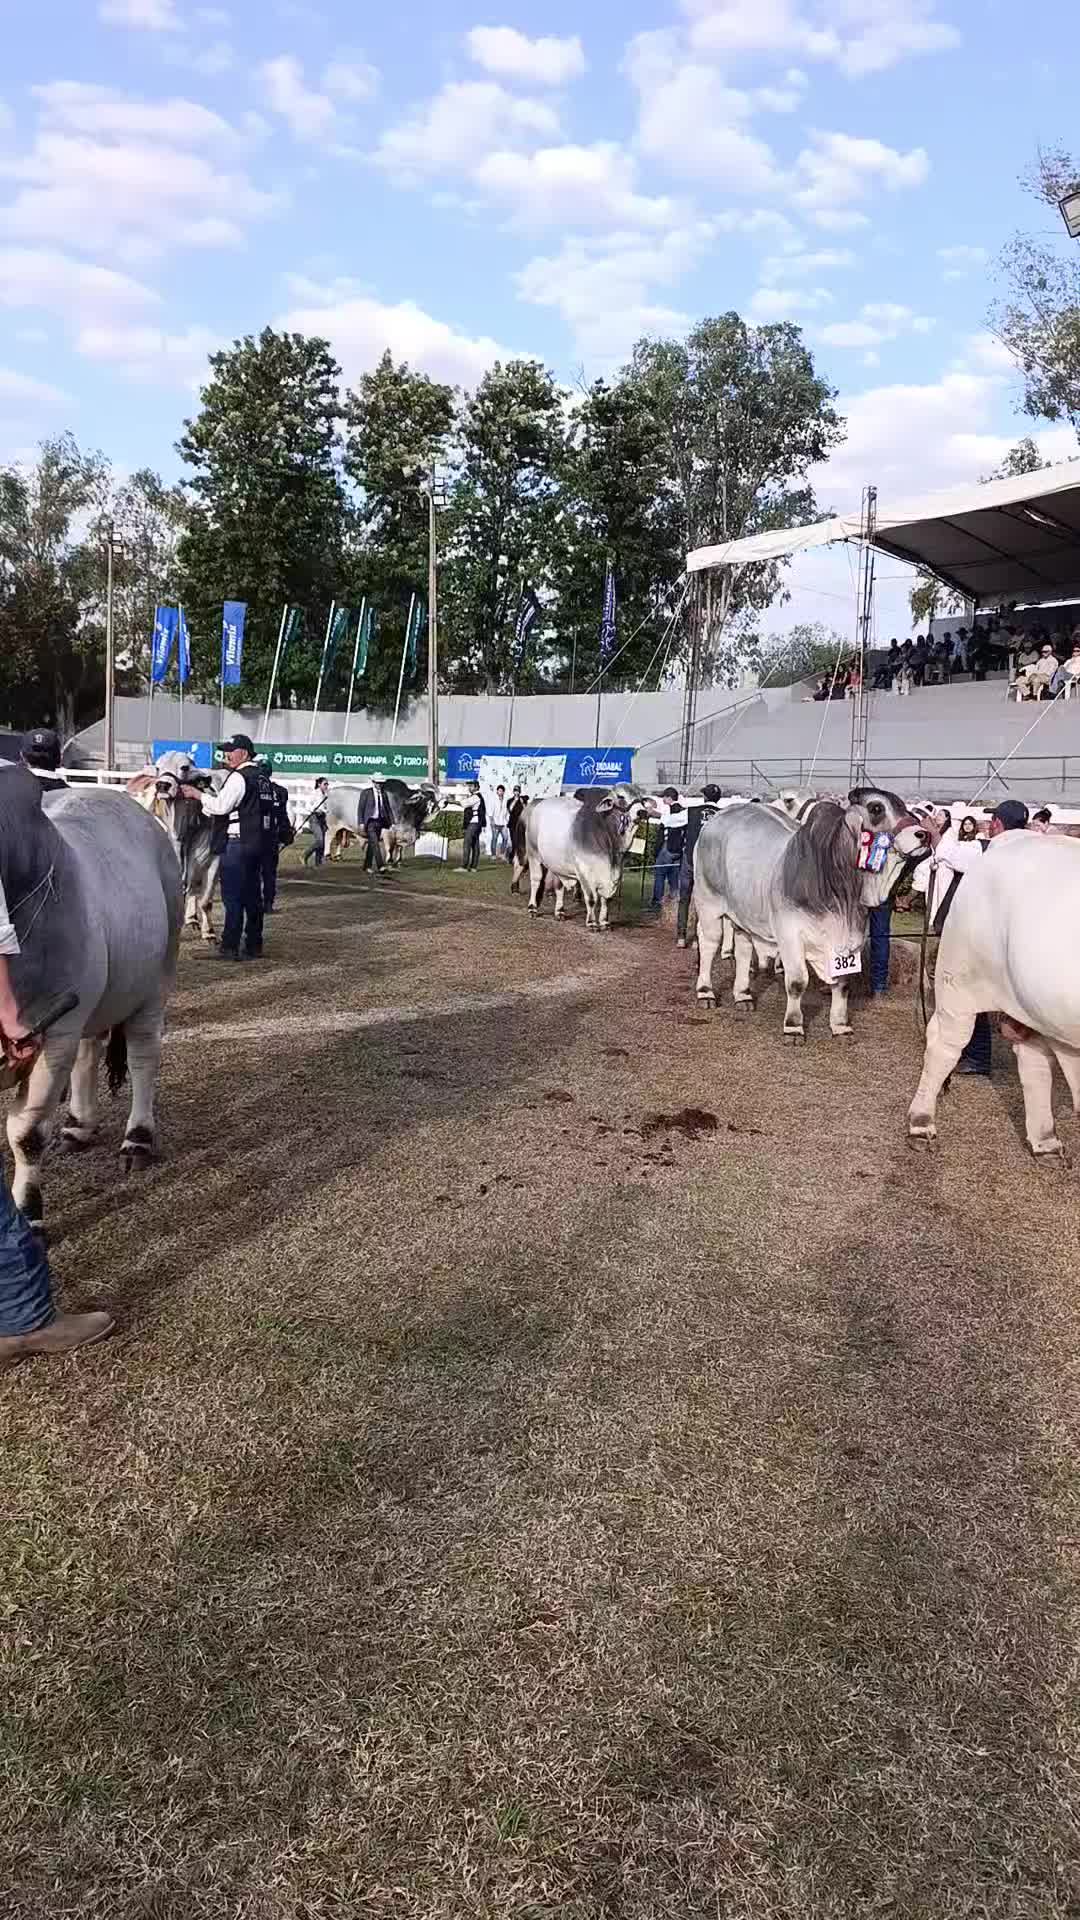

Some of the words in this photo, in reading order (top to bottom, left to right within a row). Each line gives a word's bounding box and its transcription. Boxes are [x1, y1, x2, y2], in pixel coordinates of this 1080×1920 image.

[284, 754, 303, 762] TORO
[303, 754, 328, 763] PAMPA
[343, 755, 362, 764] TORO
[363, 756, 388, 765] PAMPA
[403, 757, 422, 766] TORO
[834, 954, 857, 970] 382
